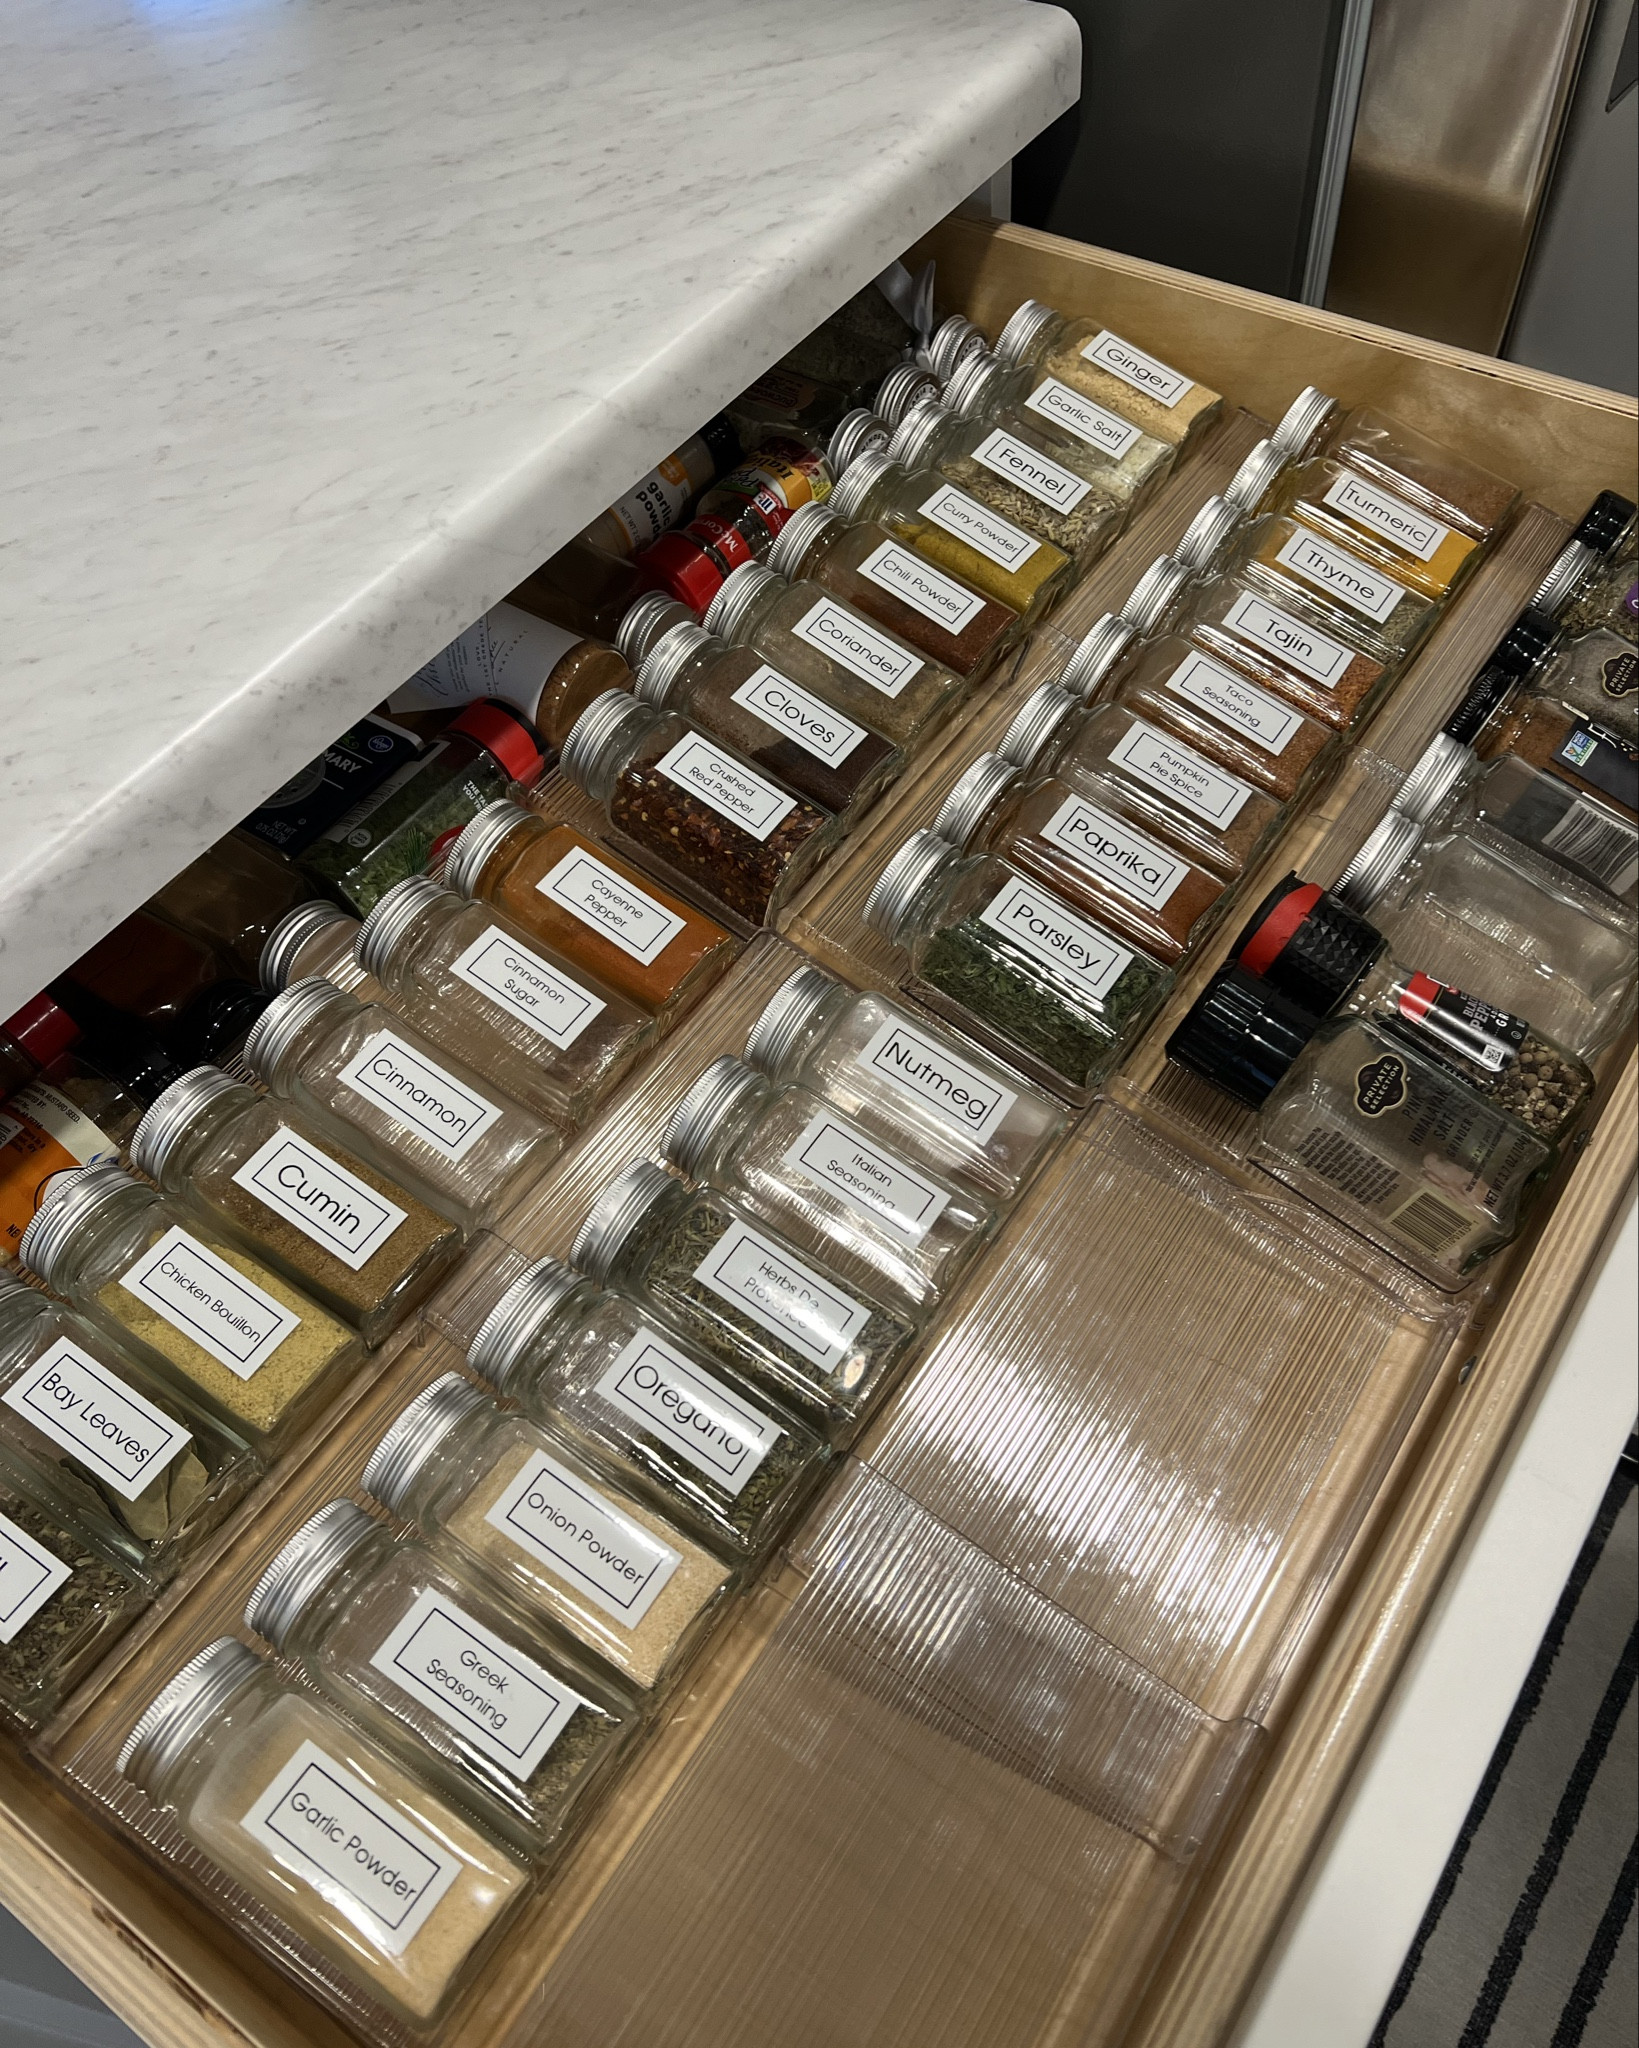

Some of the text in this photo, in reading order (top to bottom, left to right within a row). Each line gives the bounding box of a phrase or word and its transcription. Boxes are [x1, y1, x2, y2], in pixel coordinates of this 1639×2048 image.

[1107, 348, 1171, 389] Ginger
[1048, 395, 1122, 441] Garlic Salt
[998, 448, 1067, 494] Fennel
[647, 481, 671, 526] garlic
[1346, 488, 1427, 542] Turmeric
[943, 502, 1019, 552] Curry Powder
[883, 560, 962, 613] Chili Powder
[1307, 550, 1375, 599] Thyme
[819, 619, 900, 676] Coriander
[1266, 618, 1312, 657] Tajin
[1225, 685, 1253, 706] Taco
[1610, 657, 1631, 688] PRIVATE
[1615, 659, 1637, 692] SELECTION
[764, 690, 835, 743] Cloves
[1202, 686, 1261, 727] Seasoning
[461, 784, 476, 800] YOU
[466, 780, 481, 796] THE
[688, 766, 755, 814] Red Pepper
[709, 763, 756, 797] Crushed
[1149, 761, 1203, 798] Pie Spice
[1159, 751, 1210, 787] Pumpkin
[1069, 818, 1161, 885] Paprika
[583, 894, 628, 927] Pepper
[591, 879, 643, 919] Cayenne
[1012, 904, 1101, 970] Parsley
[504, 957, 565, 1004] Cinnamon
[504, 979, 540, 1007] Sugar
[44, 1092, 68, 1112] MUSTARD
[373, 1059, 466, 1133] Cinnamon
[884, 1042, 988, 1120] Nutmeg
[1363, 1062, 1392, 1104] PRIVATE
[1370, 1065, 1399, 1110] SELECTION
[1402, 1092, 1424, 1120] PINK
[1408, 1087, 1449, 1146] HIMALAYAN
[1433, 1113, 1456, 1141] SALT
[1446, 1117, 1474, 1158] GRINDER
[851, 1153, 892, 1187] Italian
[1483, 1190, 1499, 1208] NET
[1491, 1175, 1507, 1193] WT
[1505, 1154, 1518, 1168] OZ
[278, 1165, 360, 1234] Cumin
[160, 1262, 261, 1343] Chicken Bouillon
[758, 1261, 819, 1309] Herbs De
[41, 1372, 150, 1463] Bay Leaves
[634, 1365, 743, 1456] Oregano
[528, 1492, 644, 1585] Onion Powder
[426, 1659, 508, 1730] Seasoning
[460, 1650, 510, 1694] Greek
[291, 1792, 417, 1901] Garlic Powder
